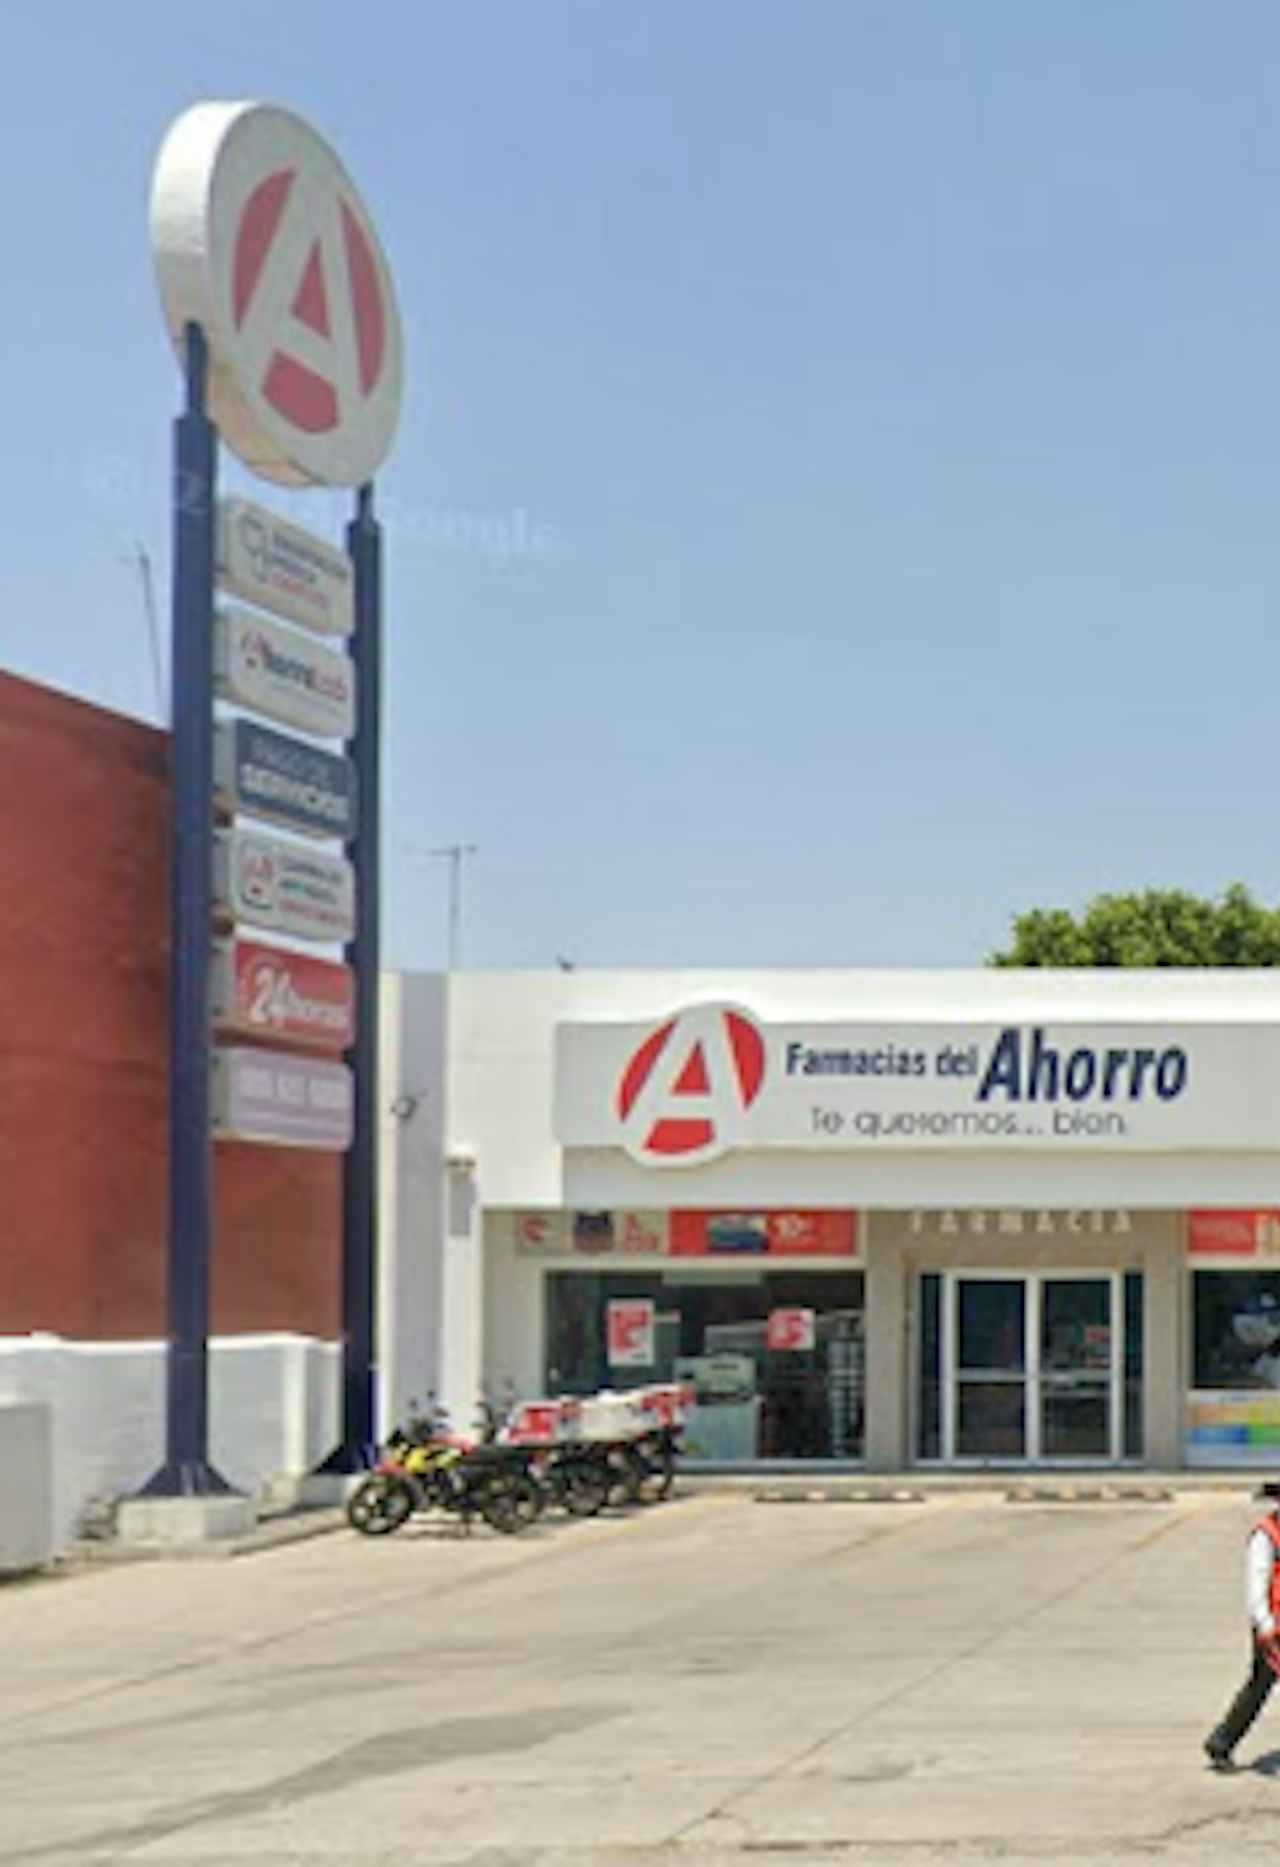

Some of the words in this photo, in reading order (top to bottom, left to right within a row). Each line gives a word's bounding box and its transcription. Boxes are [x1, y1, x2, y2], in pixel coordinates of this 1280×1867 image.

[786, 1042, 926, 1078] Farmacias
[936, 1042, 978, 1078] del
[975, 1026, 1188, 1102] Ahorro
[810, 1106, 844, 1133] Te
[908, 1208, 1132, 1233] FARMACIA
